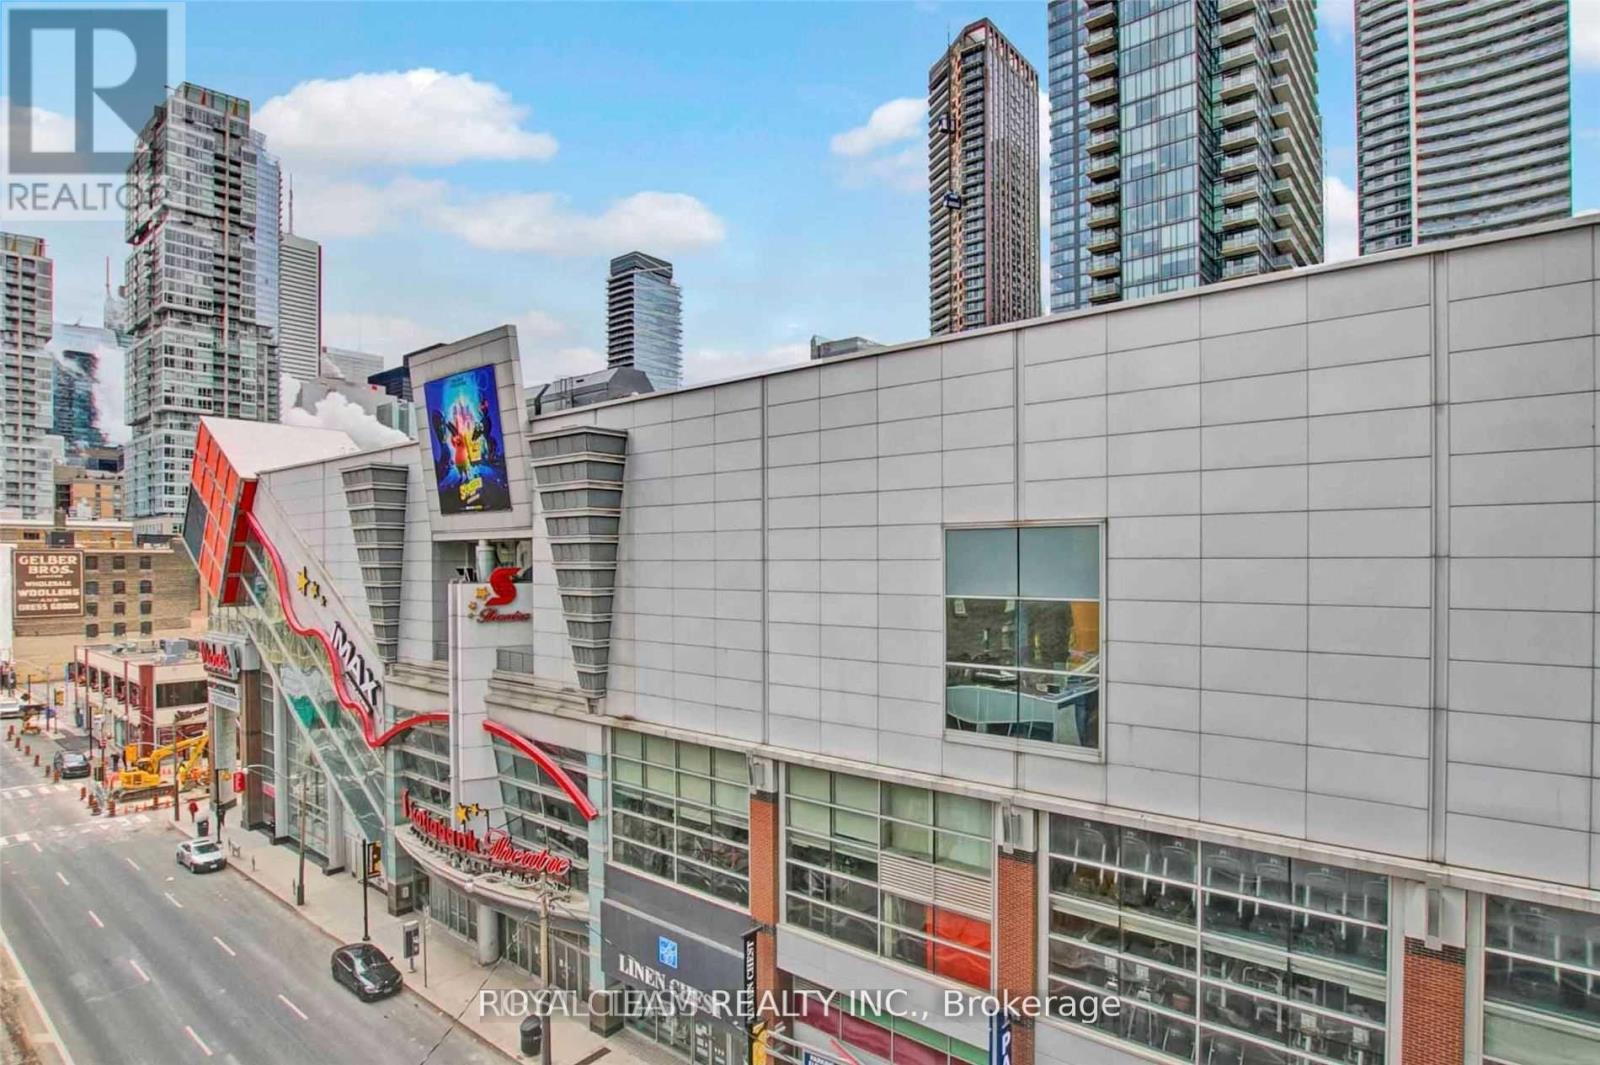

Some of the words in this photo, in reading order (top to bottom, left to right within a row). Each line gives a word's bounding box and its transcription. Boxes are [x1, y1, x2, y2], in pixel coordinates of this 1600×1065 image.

[18, 555, 78, 565] GELBER
[28, 565, 74, 574] BROS.
[17, 588, 80, 597] WOOLLENS
[619, 953, 667, 991] LINEN
